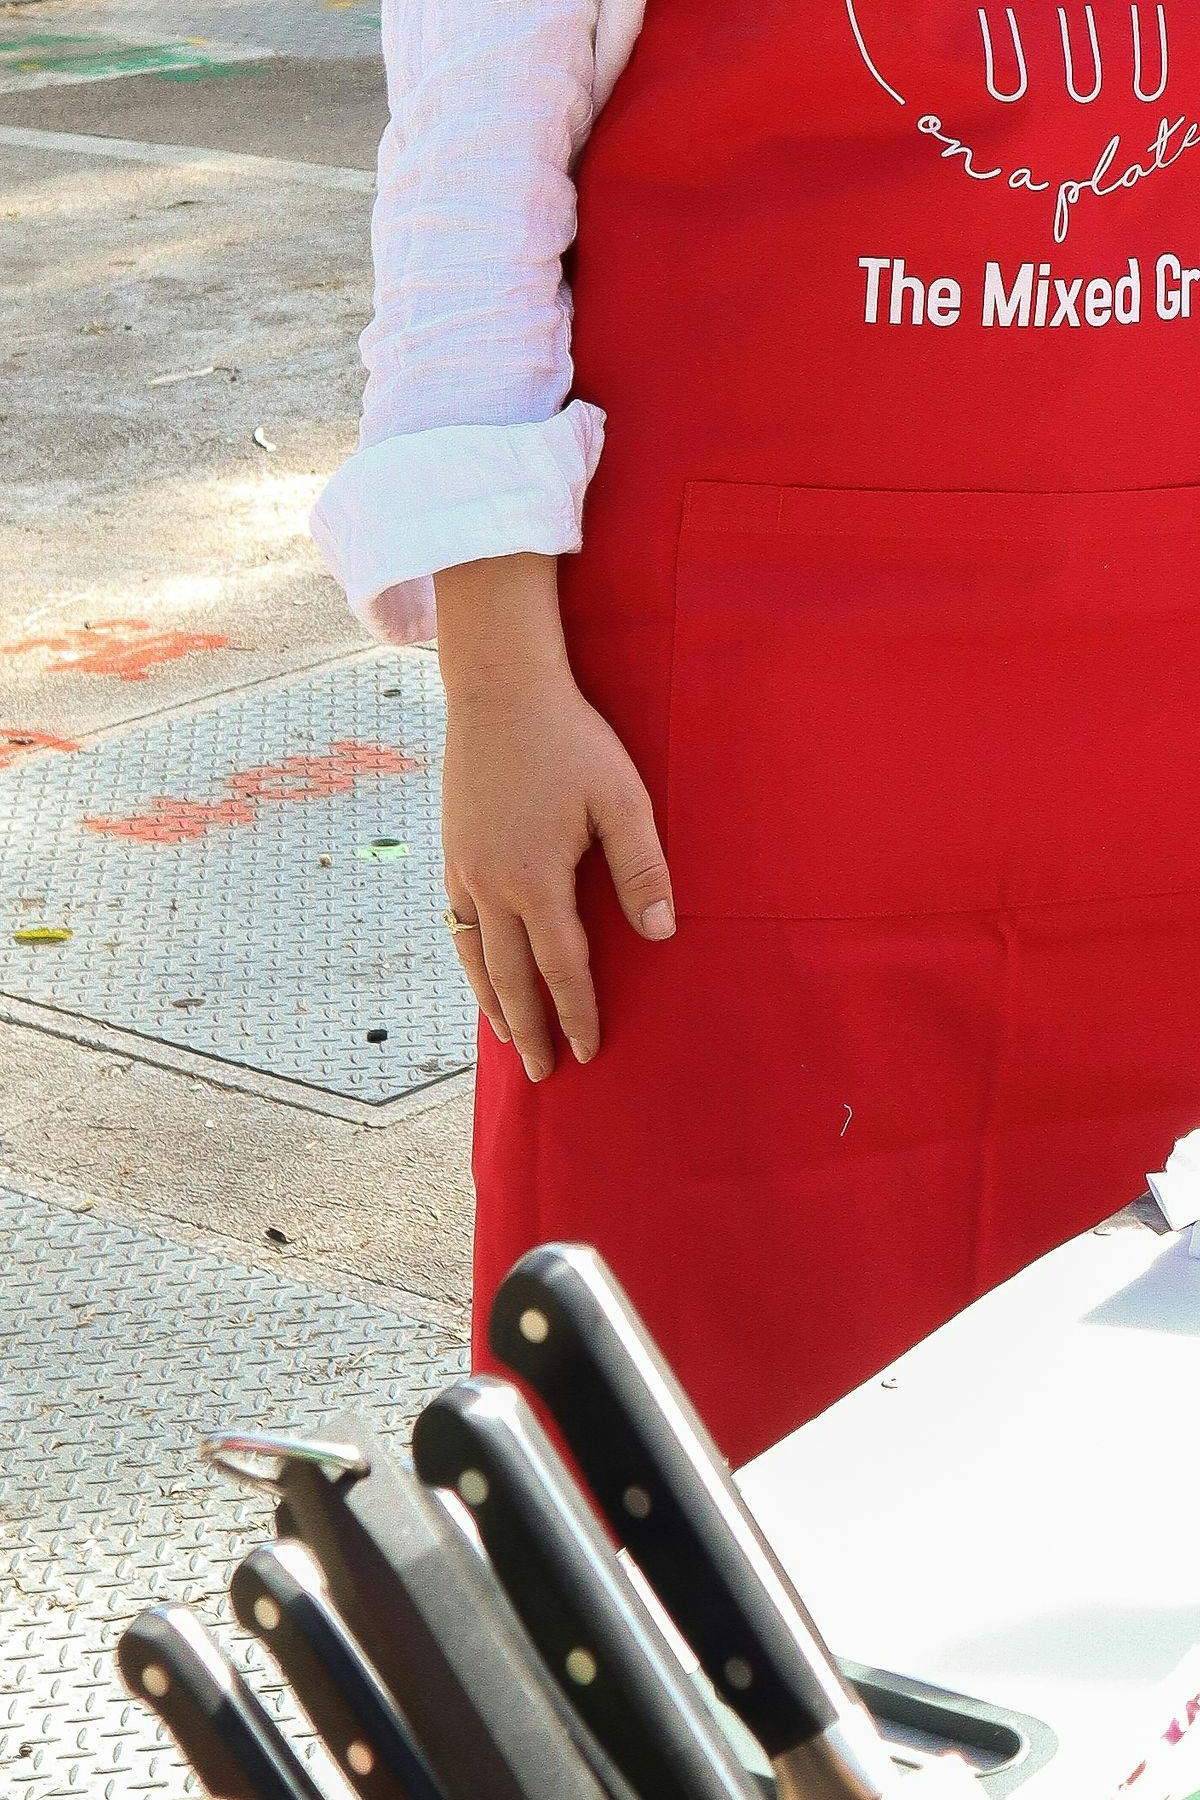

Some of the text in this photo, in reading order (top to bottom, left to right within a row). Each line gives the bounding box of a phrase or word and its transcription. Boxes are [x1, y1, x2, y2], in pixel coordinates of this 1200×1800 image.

[917, 113, 1003, 180] on
[1008, 166, 1050, 192] a
[858, 256, 962, 326] The
[981, 257, 1141, 328] Mixed
